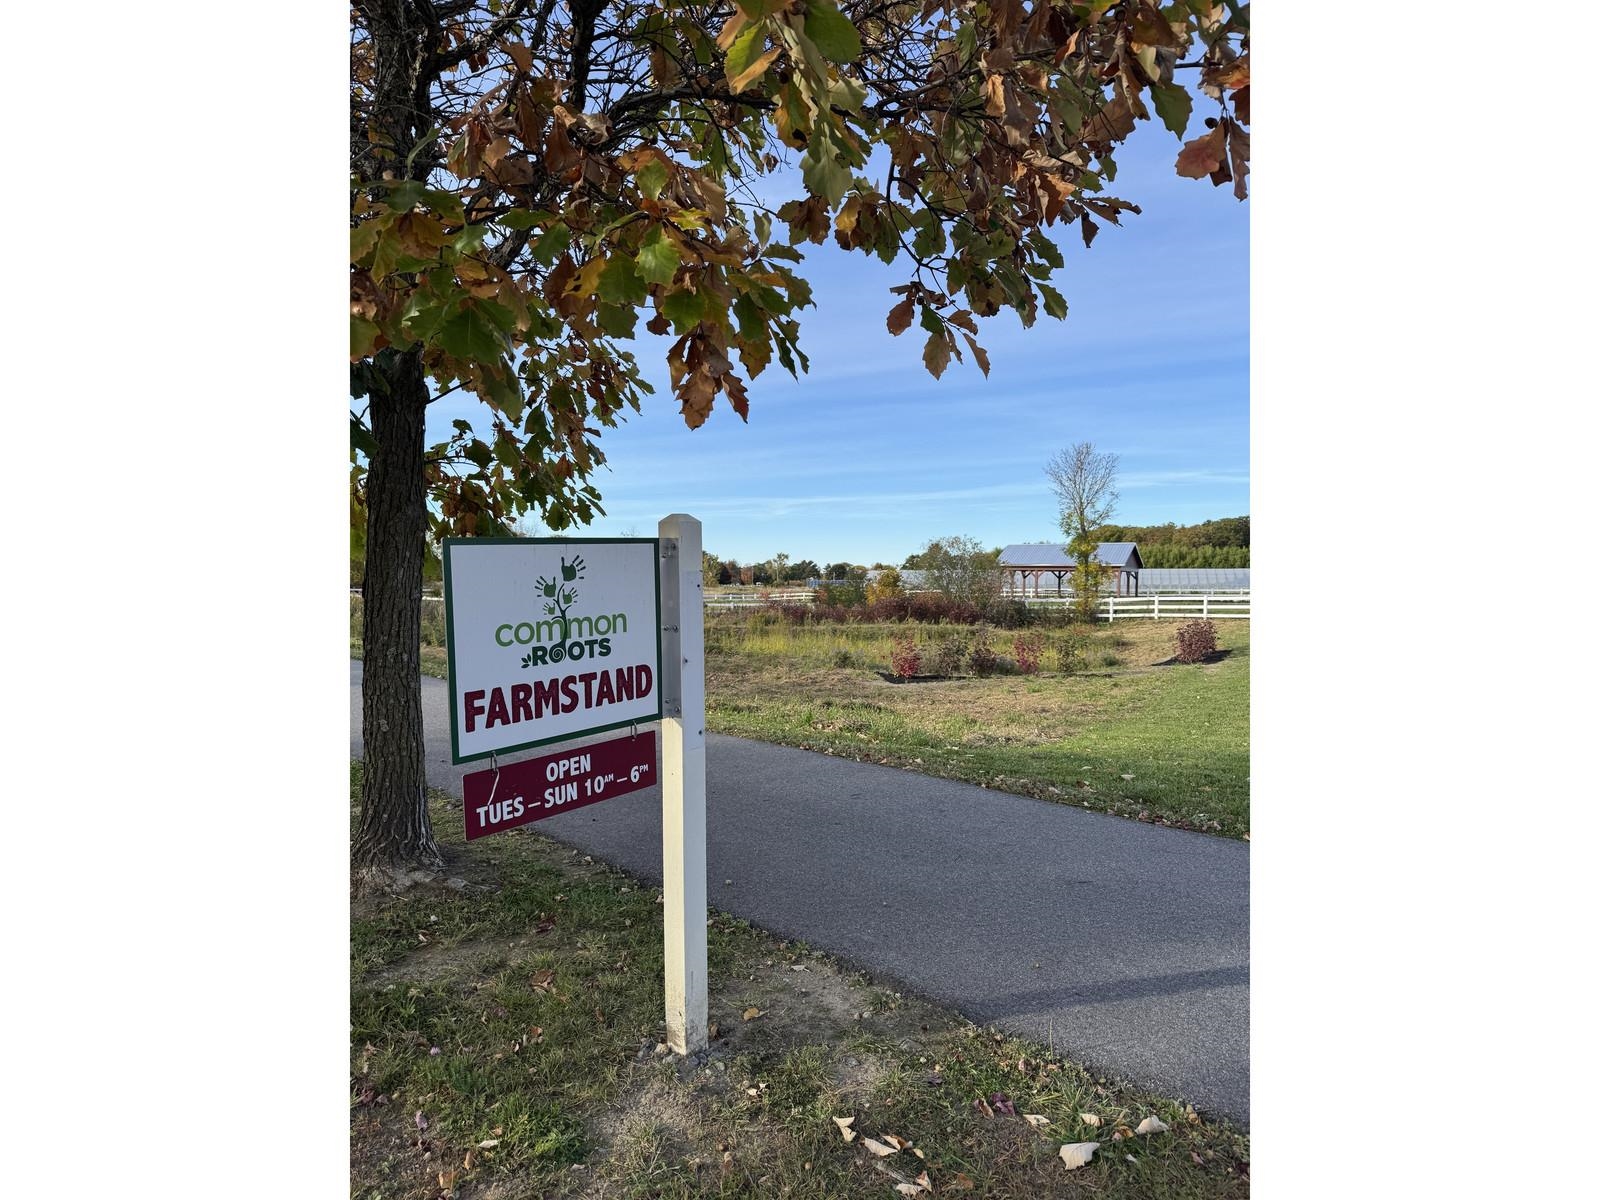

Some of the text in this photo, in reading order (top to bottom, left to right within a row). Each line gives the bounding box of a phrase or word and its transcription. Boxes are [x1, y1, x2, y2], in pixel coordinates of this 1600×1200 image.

[495, 613, 627, 647] common
[532, 638, 612, 666] ROOTS
[464, 664, 653, 733] FARMSTAND
[546, 753, 592, 782] OPEN
[476, 796, 525, 828] TUES
[544, 782, 578, 809] SUN
